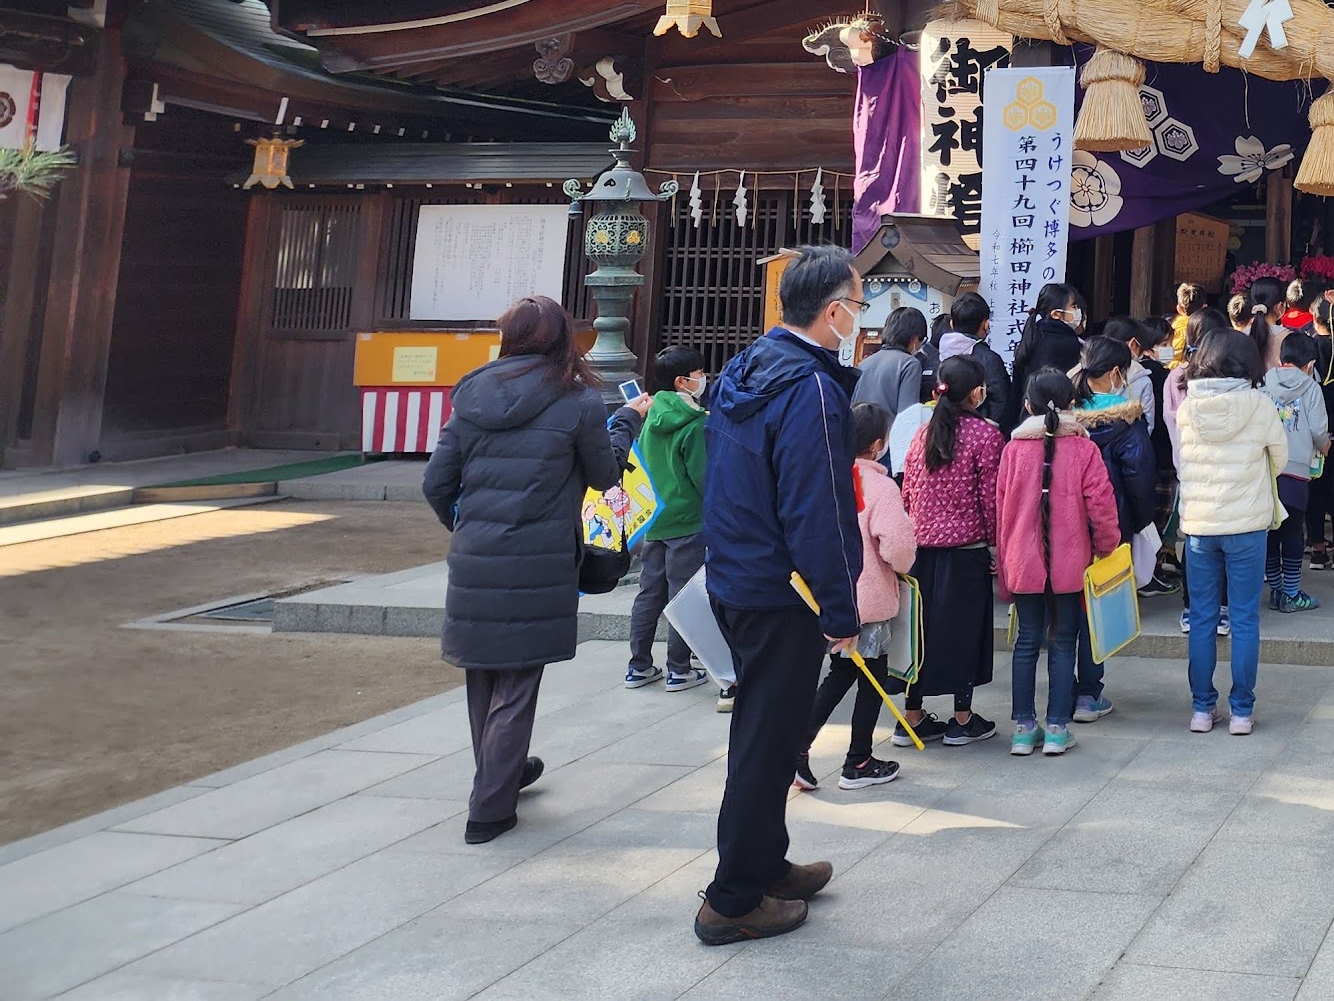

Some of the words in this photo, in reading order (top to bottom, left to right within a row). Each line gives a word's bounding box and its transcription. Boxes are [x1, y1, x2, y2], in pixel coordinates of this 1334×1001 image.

[1043, 132, 1064, 281] うけつぐ博多の
